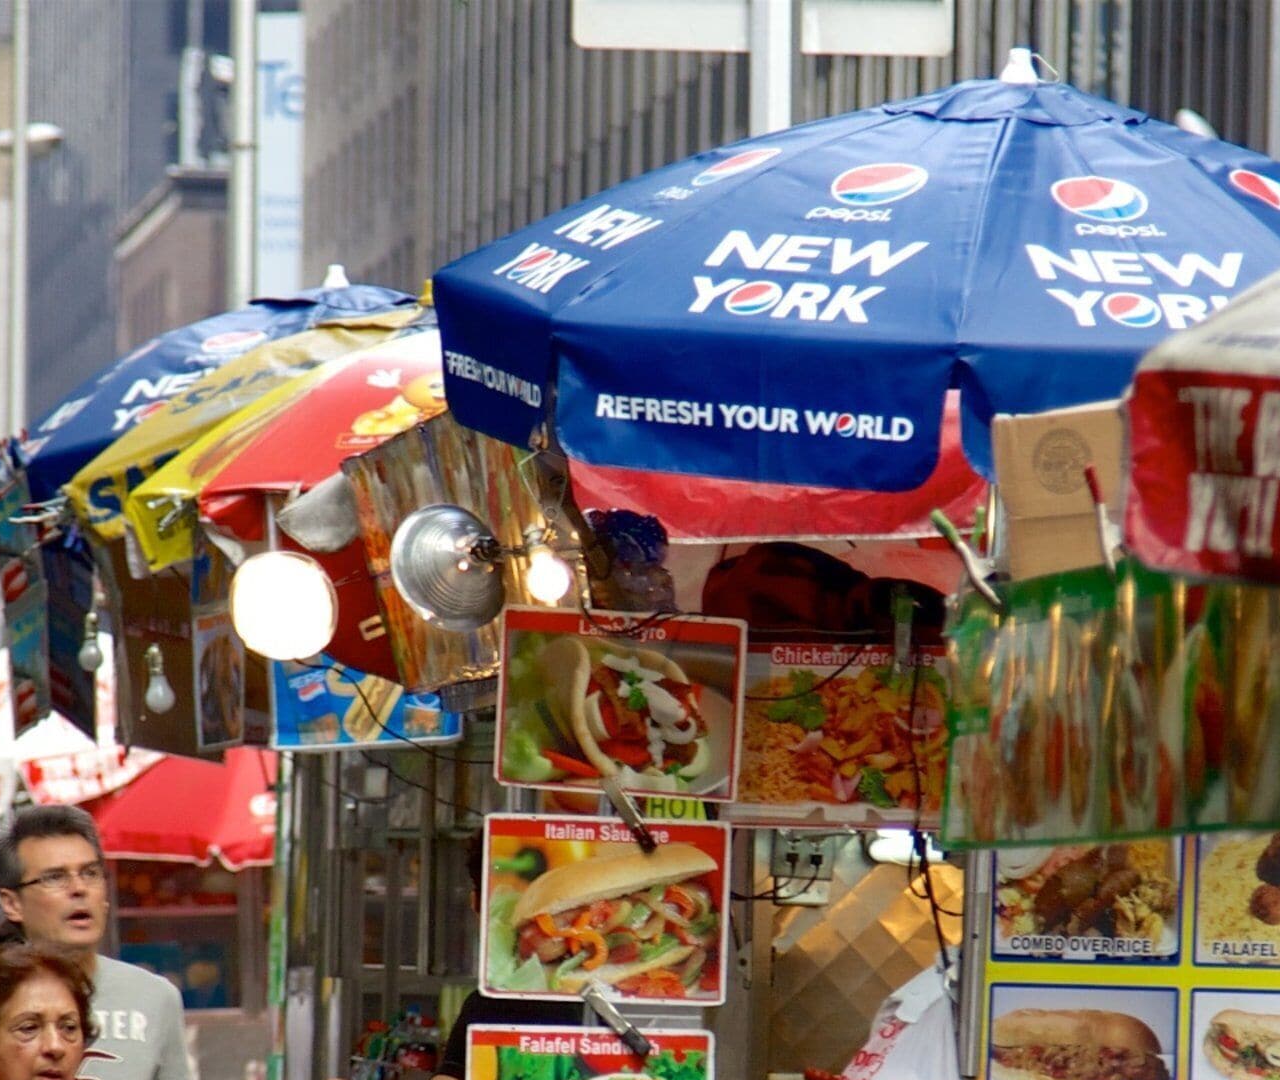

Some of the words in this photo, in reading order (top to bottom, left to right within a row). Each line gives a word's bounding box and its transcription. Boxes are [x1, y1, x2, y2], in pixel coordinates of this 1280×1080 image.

[806, 206, 892, 222] pepsi
[553, 204, 664, 250] NEW
[1076, 222, 1168, 240] pepsi
[704, 229, 931, 277] NEW
[1025, 244, 1245, 288] NEW
[687, 276, 887, 323] YORK
[596, 393, 713, 428] REFRESH
[719, 404, 800, 434] YOUR
[804, 411, 915, 442] WORLD
[545, 823, 595, 841] Italian
[1010, 936, 1066, 953] COMBO
[1069, 938, 1114, 953] OVER
[1114, 938, 1152, 954] RICE
[1212, 942, 1278, 959] FALAFEL
[519, 1035, 576, 1054] Falafel
